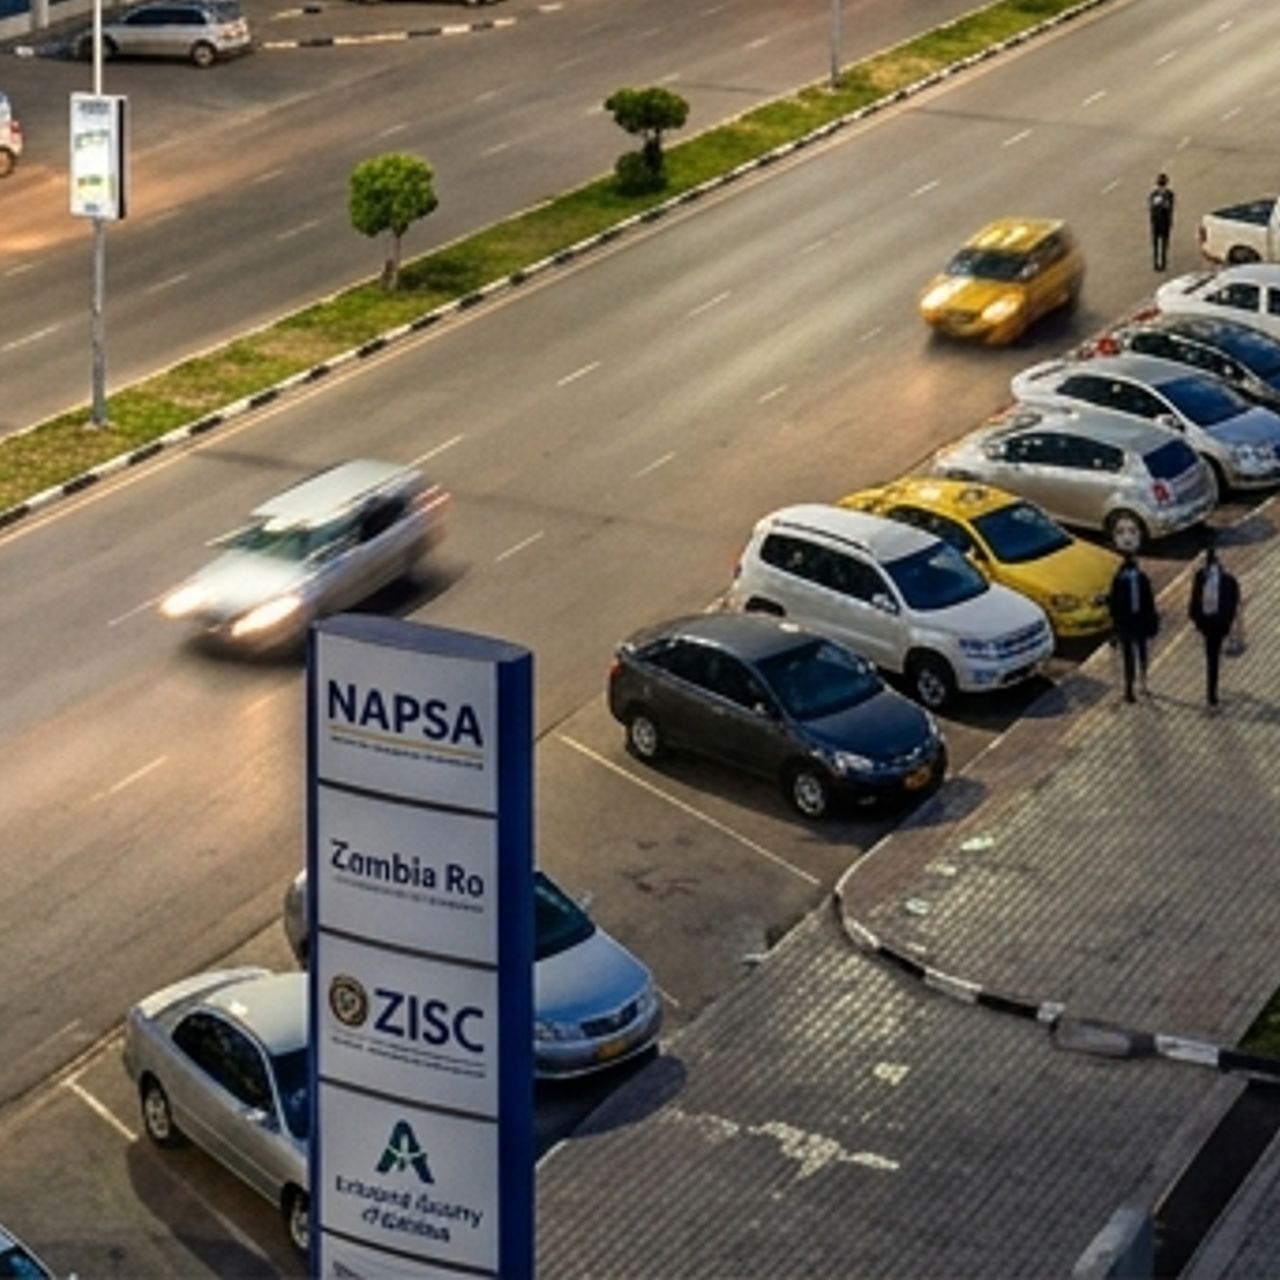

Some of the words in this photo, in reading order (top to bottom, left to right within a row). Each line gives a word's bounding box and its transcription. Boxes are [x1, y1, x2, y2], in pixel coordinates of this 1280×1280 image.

[328, 680, 483, 748] NAPSA
[445, 864, 484, 899] Ro
[374, 988, 484, 1053] ZISC
